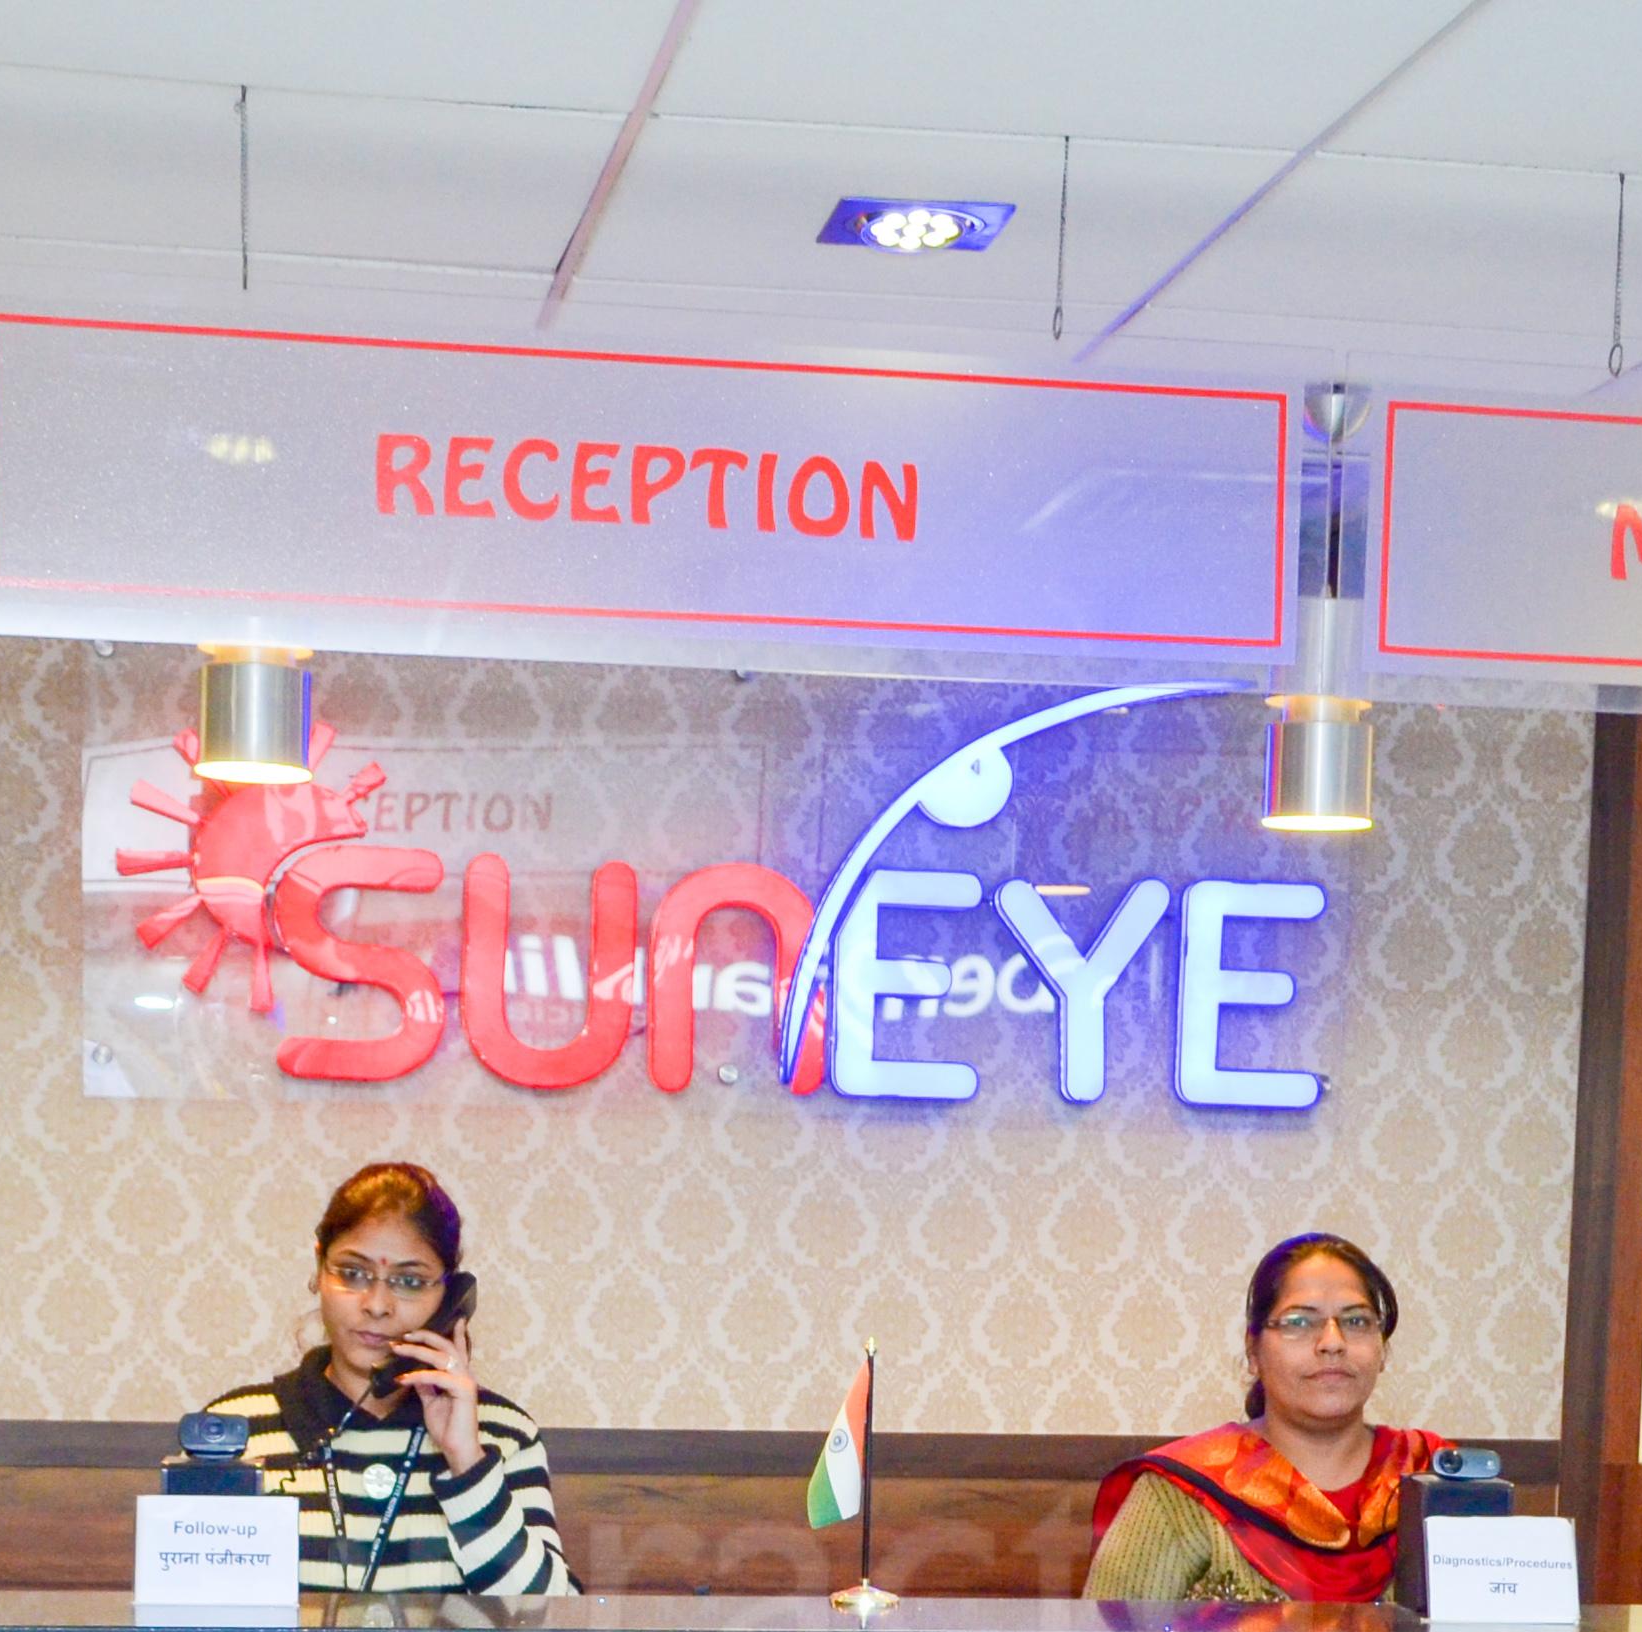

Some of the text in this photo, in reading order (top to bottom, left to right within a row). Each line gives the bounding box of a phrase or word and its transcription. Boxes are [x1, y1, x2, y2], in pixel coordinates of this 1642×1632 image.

[376, 433, 917, 541] RECEPTION
[173, 1521, 257, 1538] Follow-up
[159, 1551, 200, 1571] पुराना
